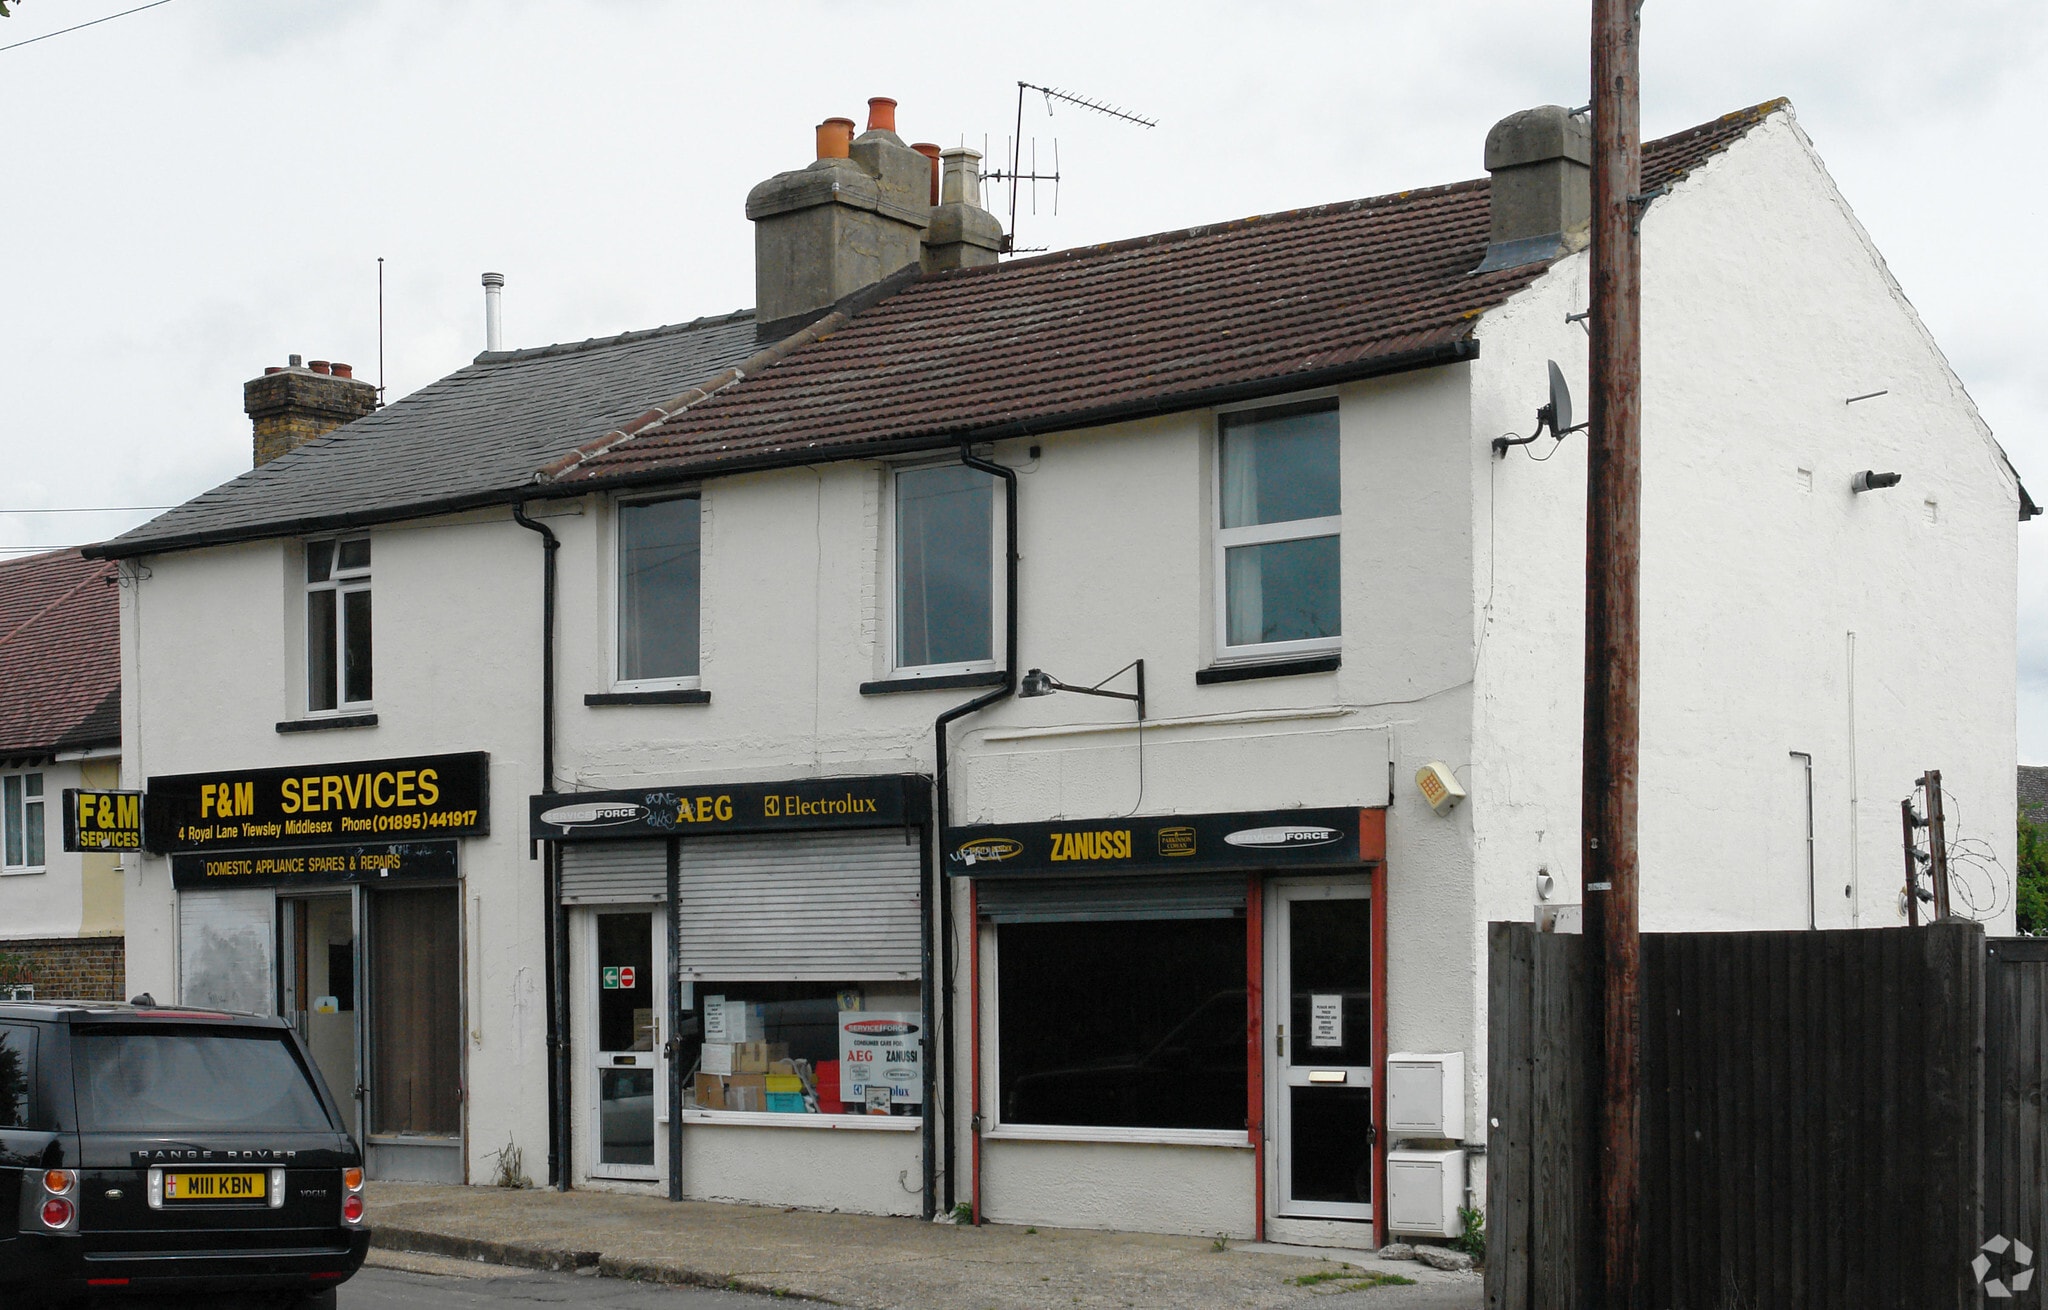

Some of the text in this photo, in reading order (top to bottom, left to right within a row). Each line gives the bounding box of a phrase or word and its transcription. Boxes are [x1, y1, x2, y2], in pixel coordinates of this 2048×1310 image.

[201, 768, 440, 819] F&M SERVICES
[79, 794, 139, 829] F&M
[675, 795, 733, 823] AEG
[784, 792, 877, 816] Electrolux
[546, 808, 636, 821] SERVICE FORCE
[178, 826, 185, 841] 4
[188, 825, 213, 842] Royal
[216, 824, 238, 839] Lane
[242, 821, 281, 838] Yiewsley
[285, 819, 333, 835] Middlesex
[341, 817, 372, 832] Phone
[1229, 831, 1329, 843] SERVICE FORCE
[80, 831, 139, 848] SERVICES
[1050, 830, 1132, 862] ZANUSSI
[206, 854, 401, 877] DOMESTIC APPLIANCE SPARES & REPAIRS
[848, 1024, 908, 1033] SERVICE FORCE
[847, 1050, 873, 1062] AEG
[886, 1050, 918, 1063] ZANUSSI
[138, 1150, 297, 1159] RANGE ROVER
[219, 1177, 252, 1194] KBN
[300, 1189, 327, 1197] VOGUE
